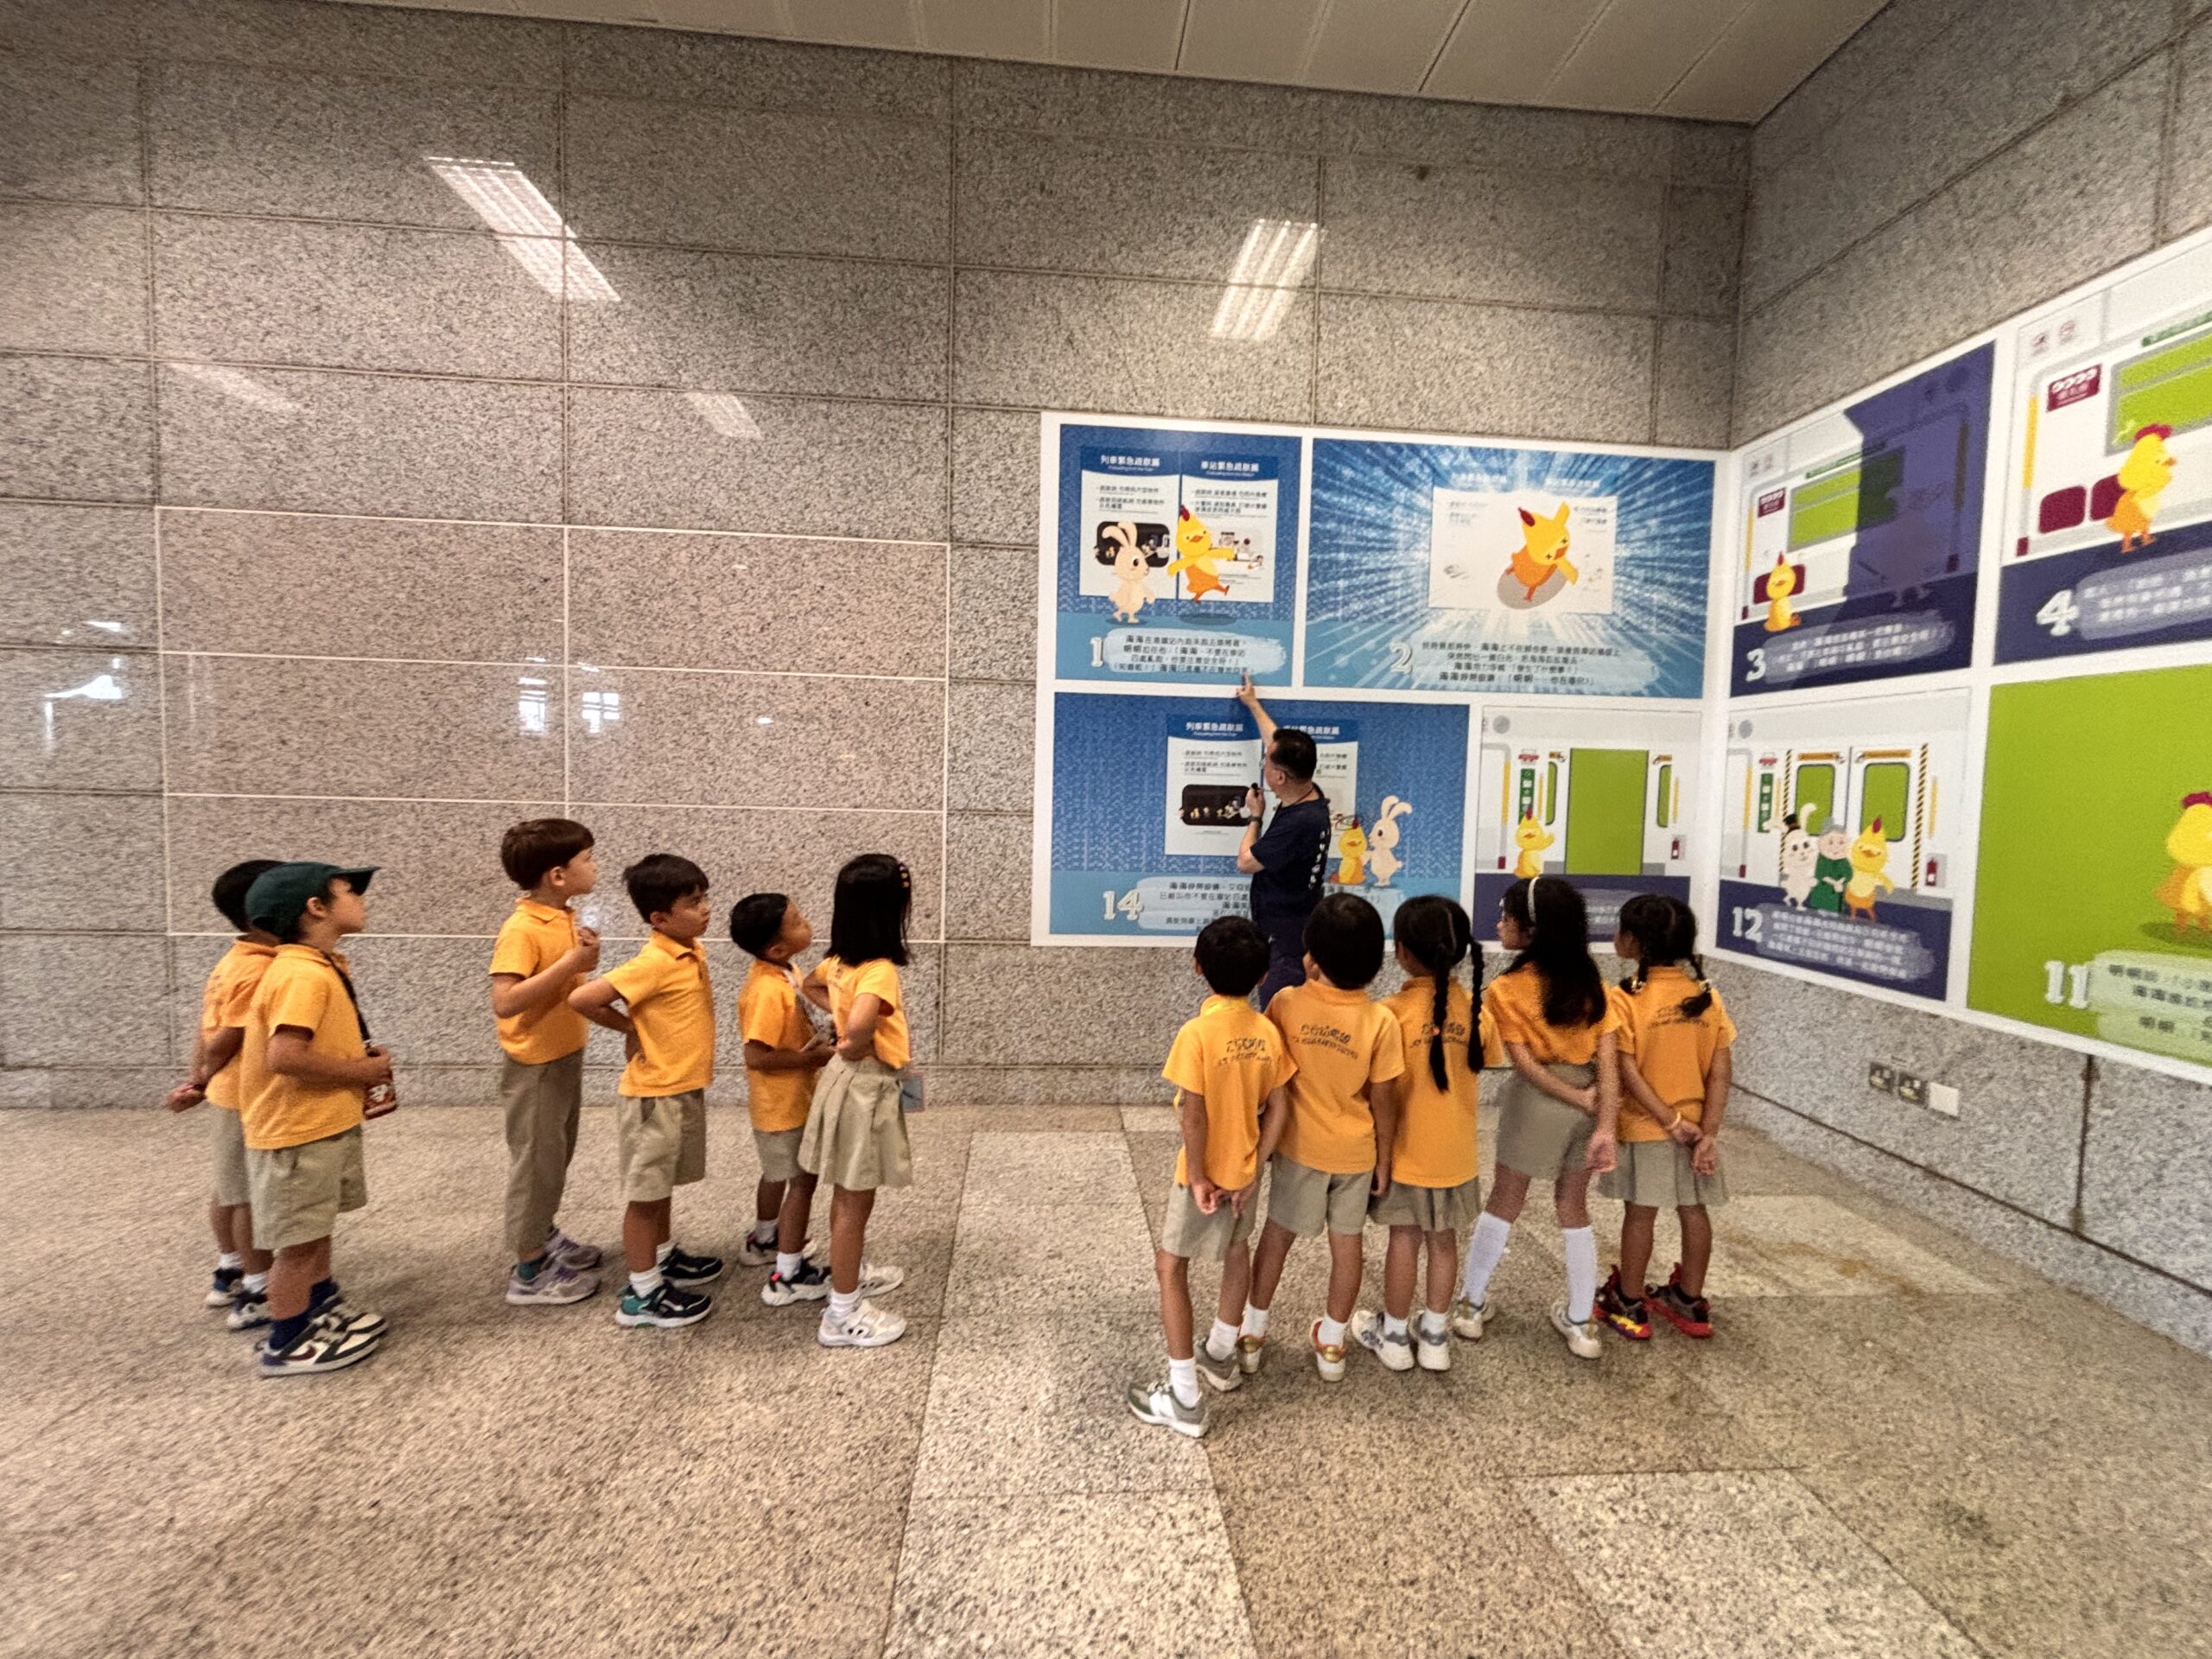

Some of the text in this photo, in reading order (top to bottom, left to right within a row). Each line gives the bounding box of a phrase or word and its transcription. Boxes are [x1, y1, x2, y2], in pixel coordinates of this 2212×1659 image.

[2036, 588, 2080, 637] 4
[1090, 636, 1103, 668] 1
[1390, 639, 1413, 674] 2
[1745, 648, 1767, 683] 3
[1102, 889, 1145, 921] 14
[1732, 906, 1764, 944] 12
[2044, 960, 2089, 1009] 11
